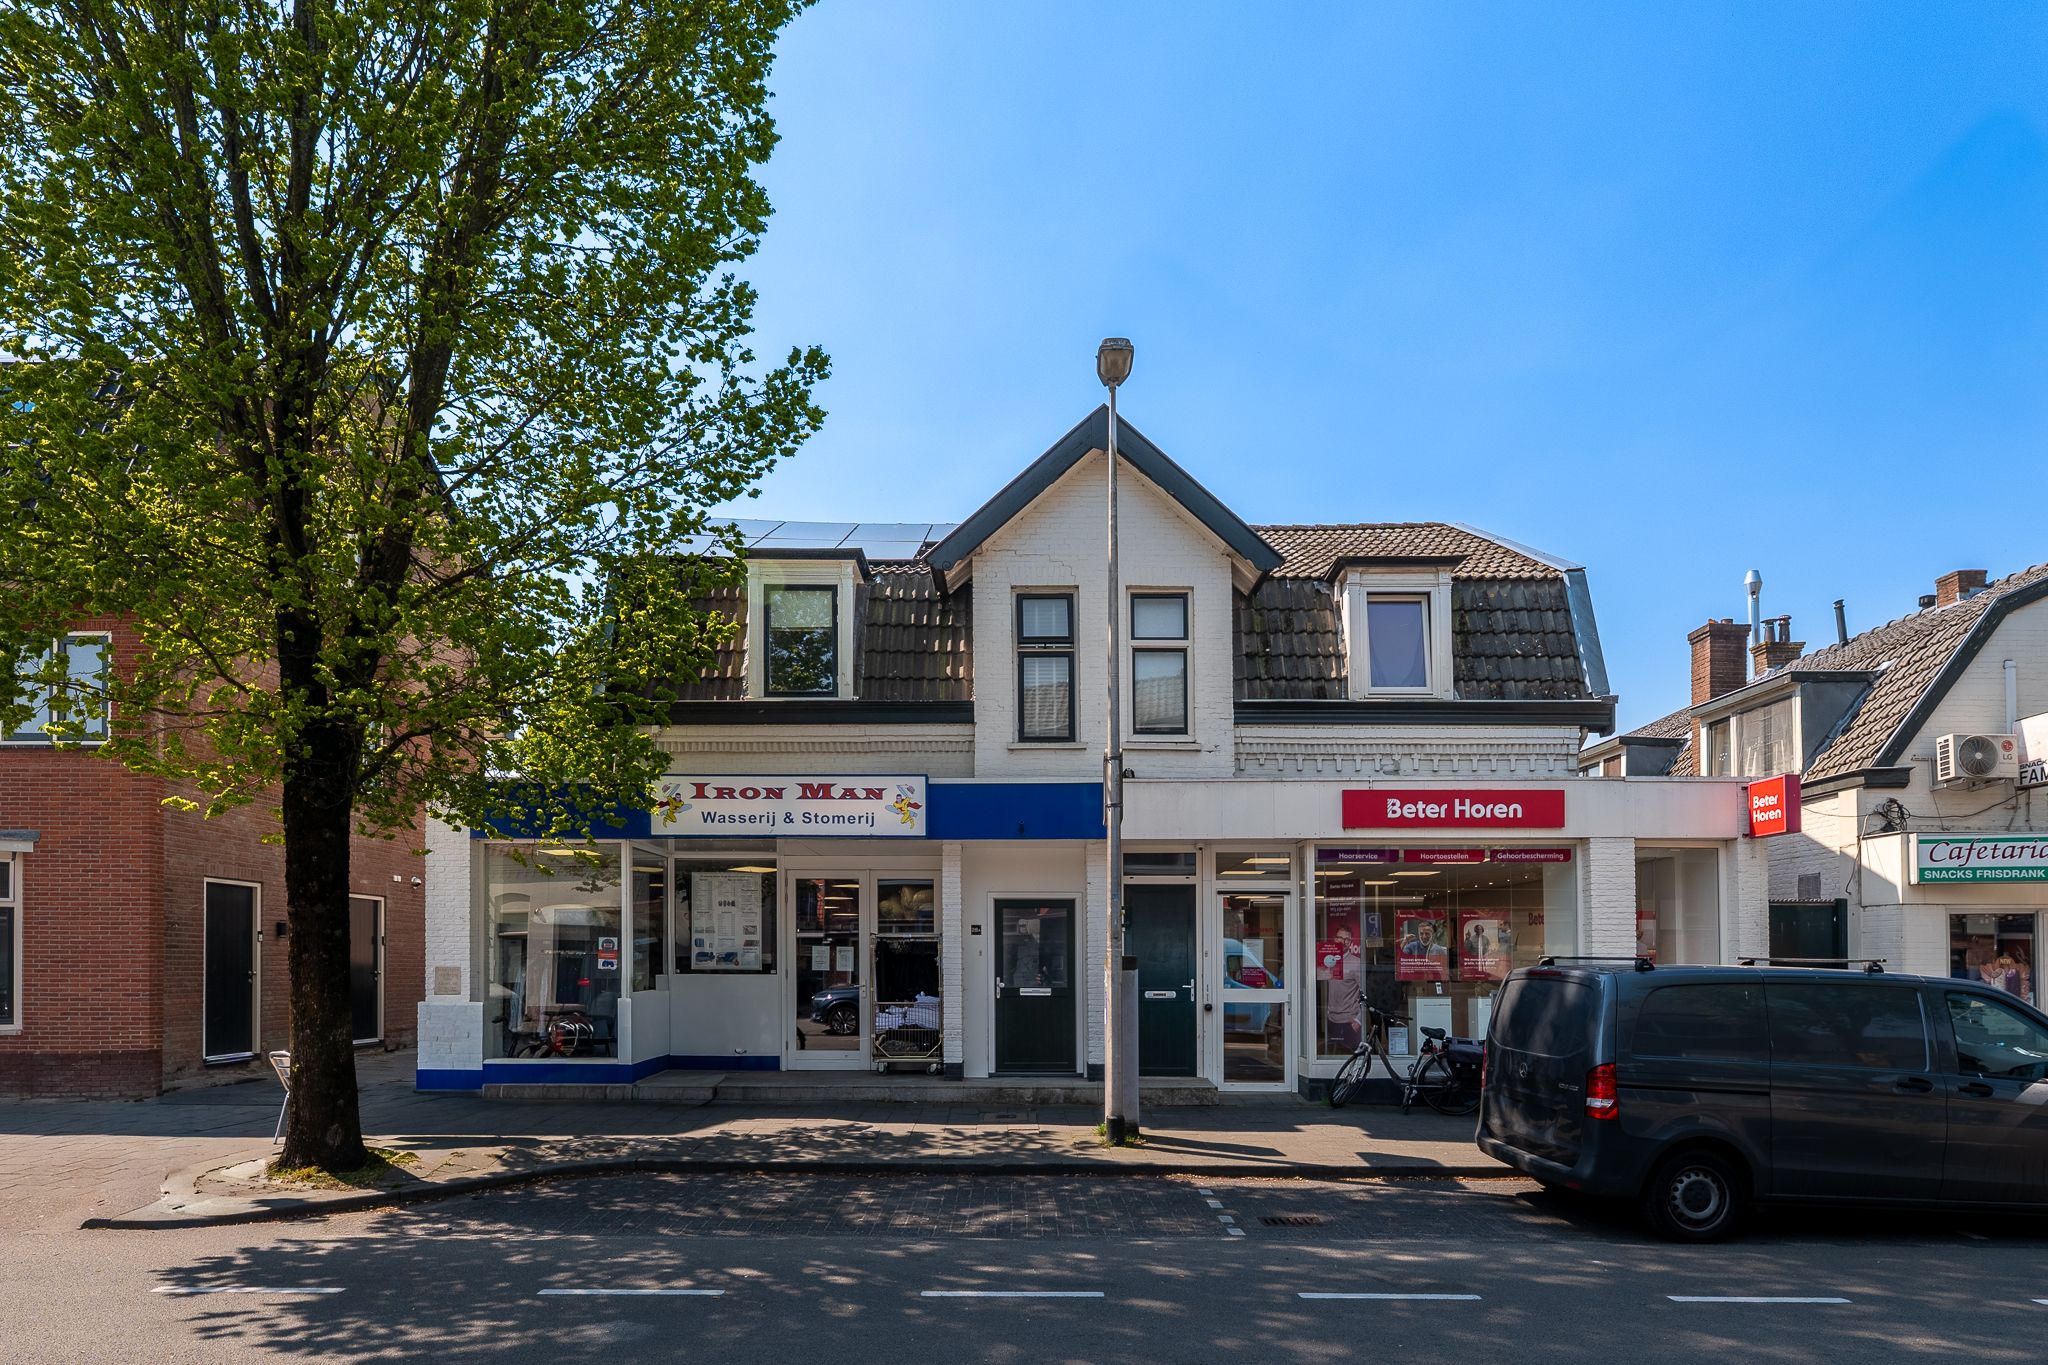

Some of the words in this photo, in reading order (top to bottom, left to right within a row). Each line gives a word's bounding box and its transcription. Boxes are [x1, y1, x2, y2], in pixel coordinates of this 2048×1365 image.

[690, 782, 787, 800] IRON
[796, 783, 888, 800] MAN
[1387, 798, 1447, 818] Beter
[1454, 798, 1523, 818] Horen
[1753, 794, 1778, 809] Beter
[701, 811, 776, 827] Wasserij
[783, 812, 795, 824] &
[801, 811, 875, 827] Stomerij
[1753, 809, 1782, 823] Horen
[1338, 852, 1378, 860] Hoorservice
[1420, 852, 1469, 860] Hoortoestellen
[1497, 852, 1564, 860] Gehoorbescherming
[1924, 870, 1973, 879] SNACKS
[1976, 869, 2046, 878] FRISDRANK
